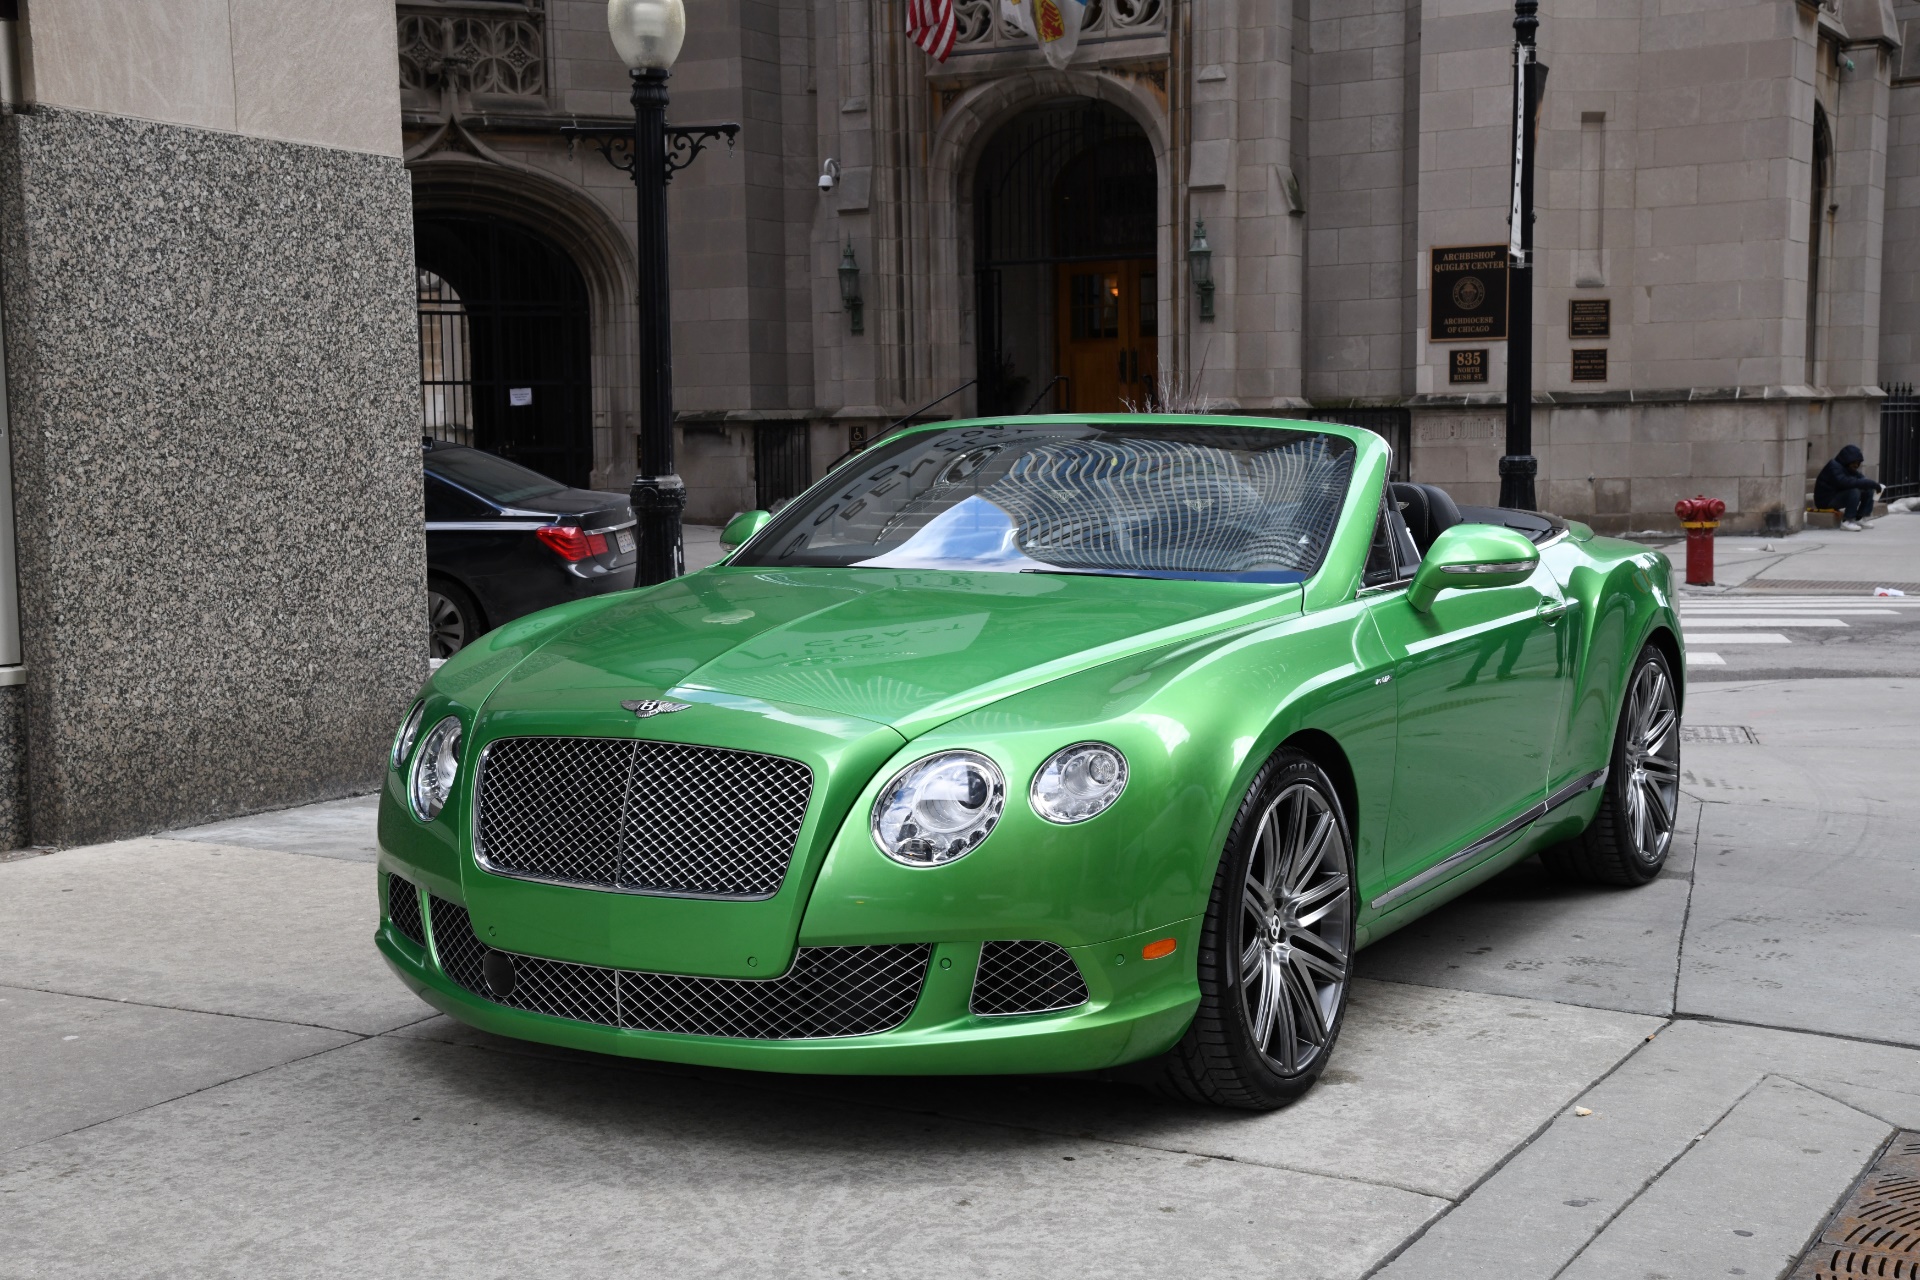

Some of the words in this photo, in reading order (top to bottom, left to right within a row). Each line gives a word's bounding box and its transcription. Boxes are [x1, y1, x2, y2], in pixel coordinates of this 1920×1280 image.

[1443, 251, 1496, 261] ARCHBISHOP
[1434, 262, 1469, 272] QUIGLEY
[1471, 261, 1504, 270] CENTER
[1444, 317, 1493, 325] ARCHDIOCESE
[1456, 352, 1481, 366] 835
